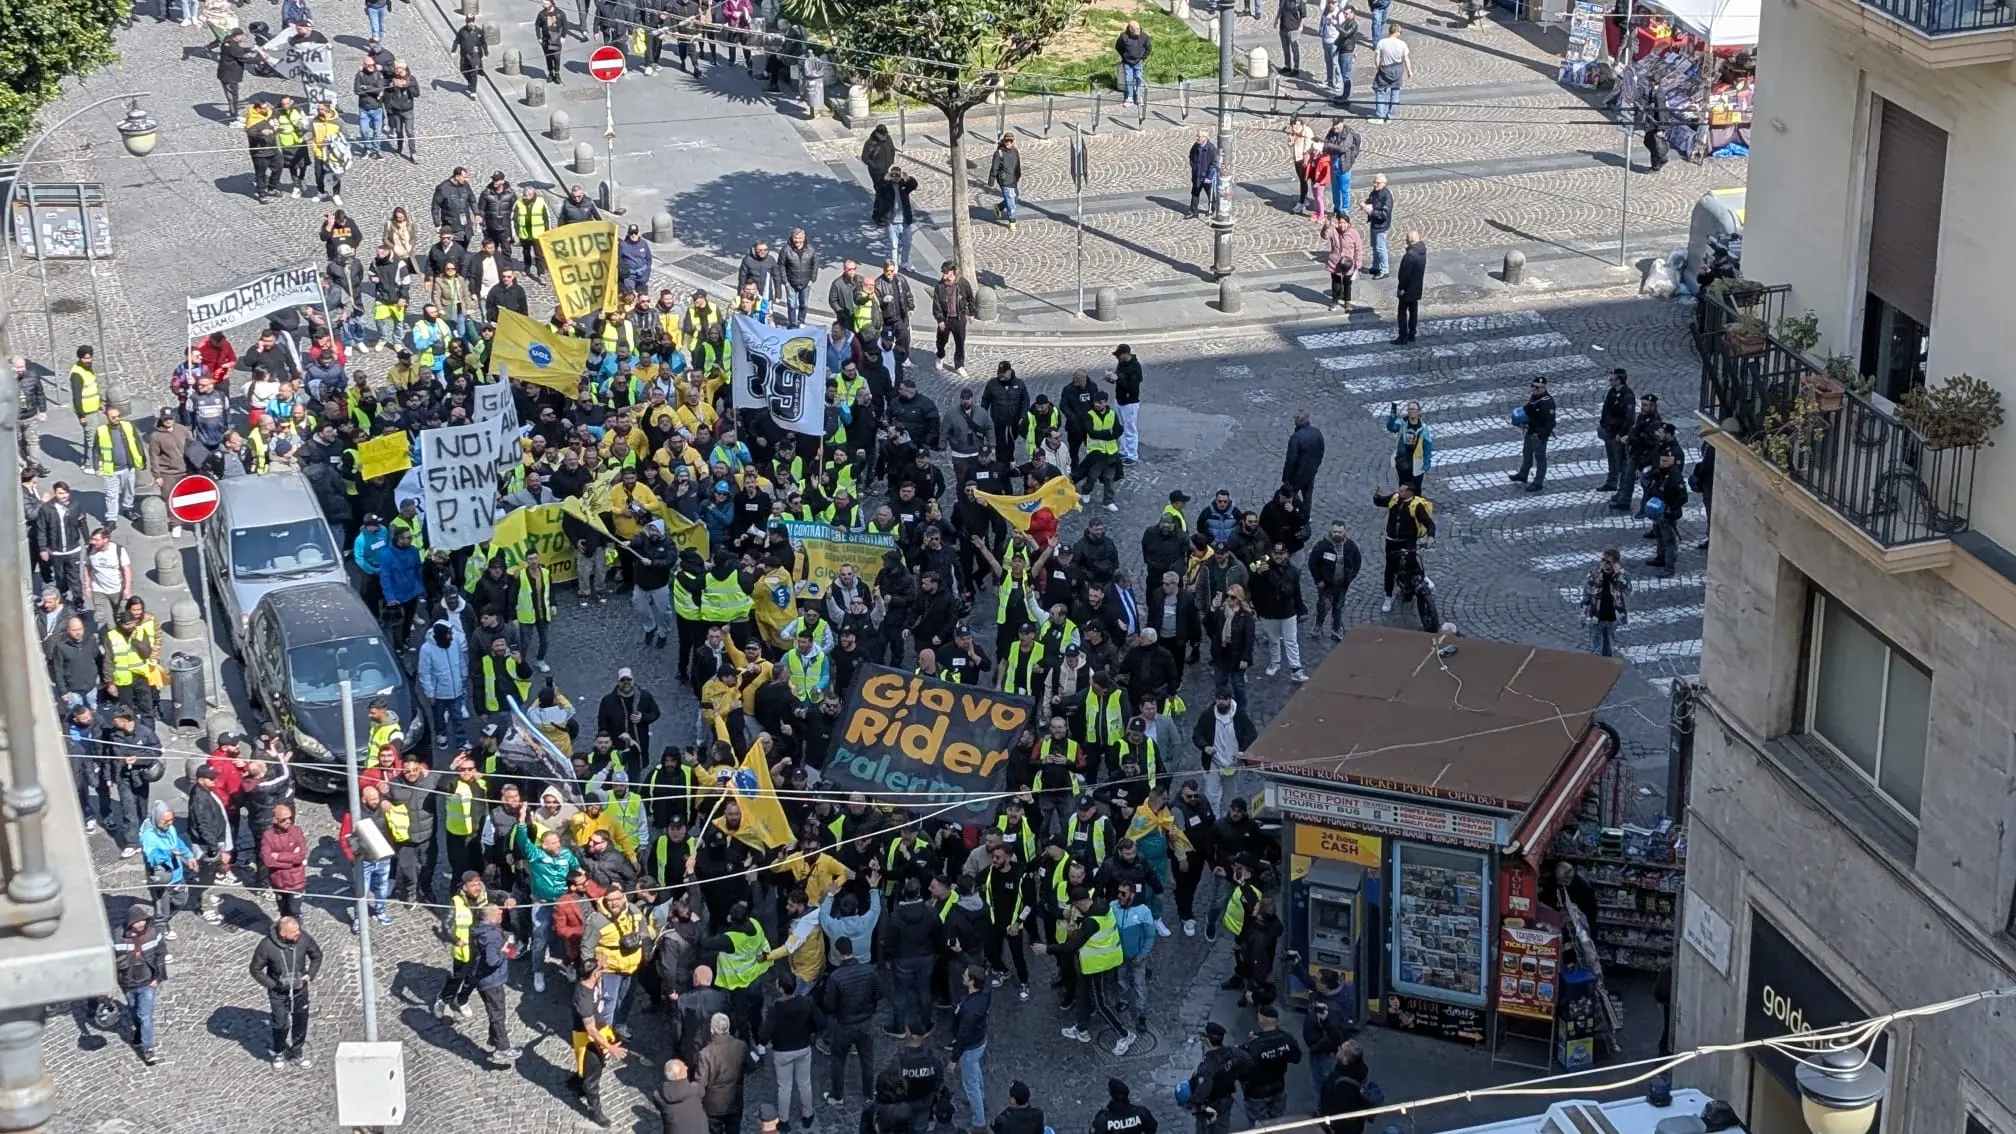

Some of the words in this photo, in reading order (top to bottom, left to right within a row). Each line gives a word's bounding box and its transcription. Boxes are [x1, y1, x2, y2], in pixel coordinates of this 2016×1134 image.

[240, 269, 317, 306] CATANIA
[565, 284, 604, 314] NAP
[747, 348, 805, 423] 39
[845, 707, 1009, 777] Rider
[1360, 776, 1400, 790] TICKET
[1403, 782, 1440, 797] POINT
[1283, 788, 1323, 802] TICKET
[1326, 794, 1360, 807] POINT
[1283, 798, 1330, 811] TOURIST
[1337, 806, 1360, 816] BUS
[1321, 831, 1333, 840] 24
[1336, 835, 1359, 845] hour
[1321, 840, 1359, 856] CASH
[902, 1066, 936, 1079] POLIZIA
[1107, 1115, 1142, 1131] POLIZIA
